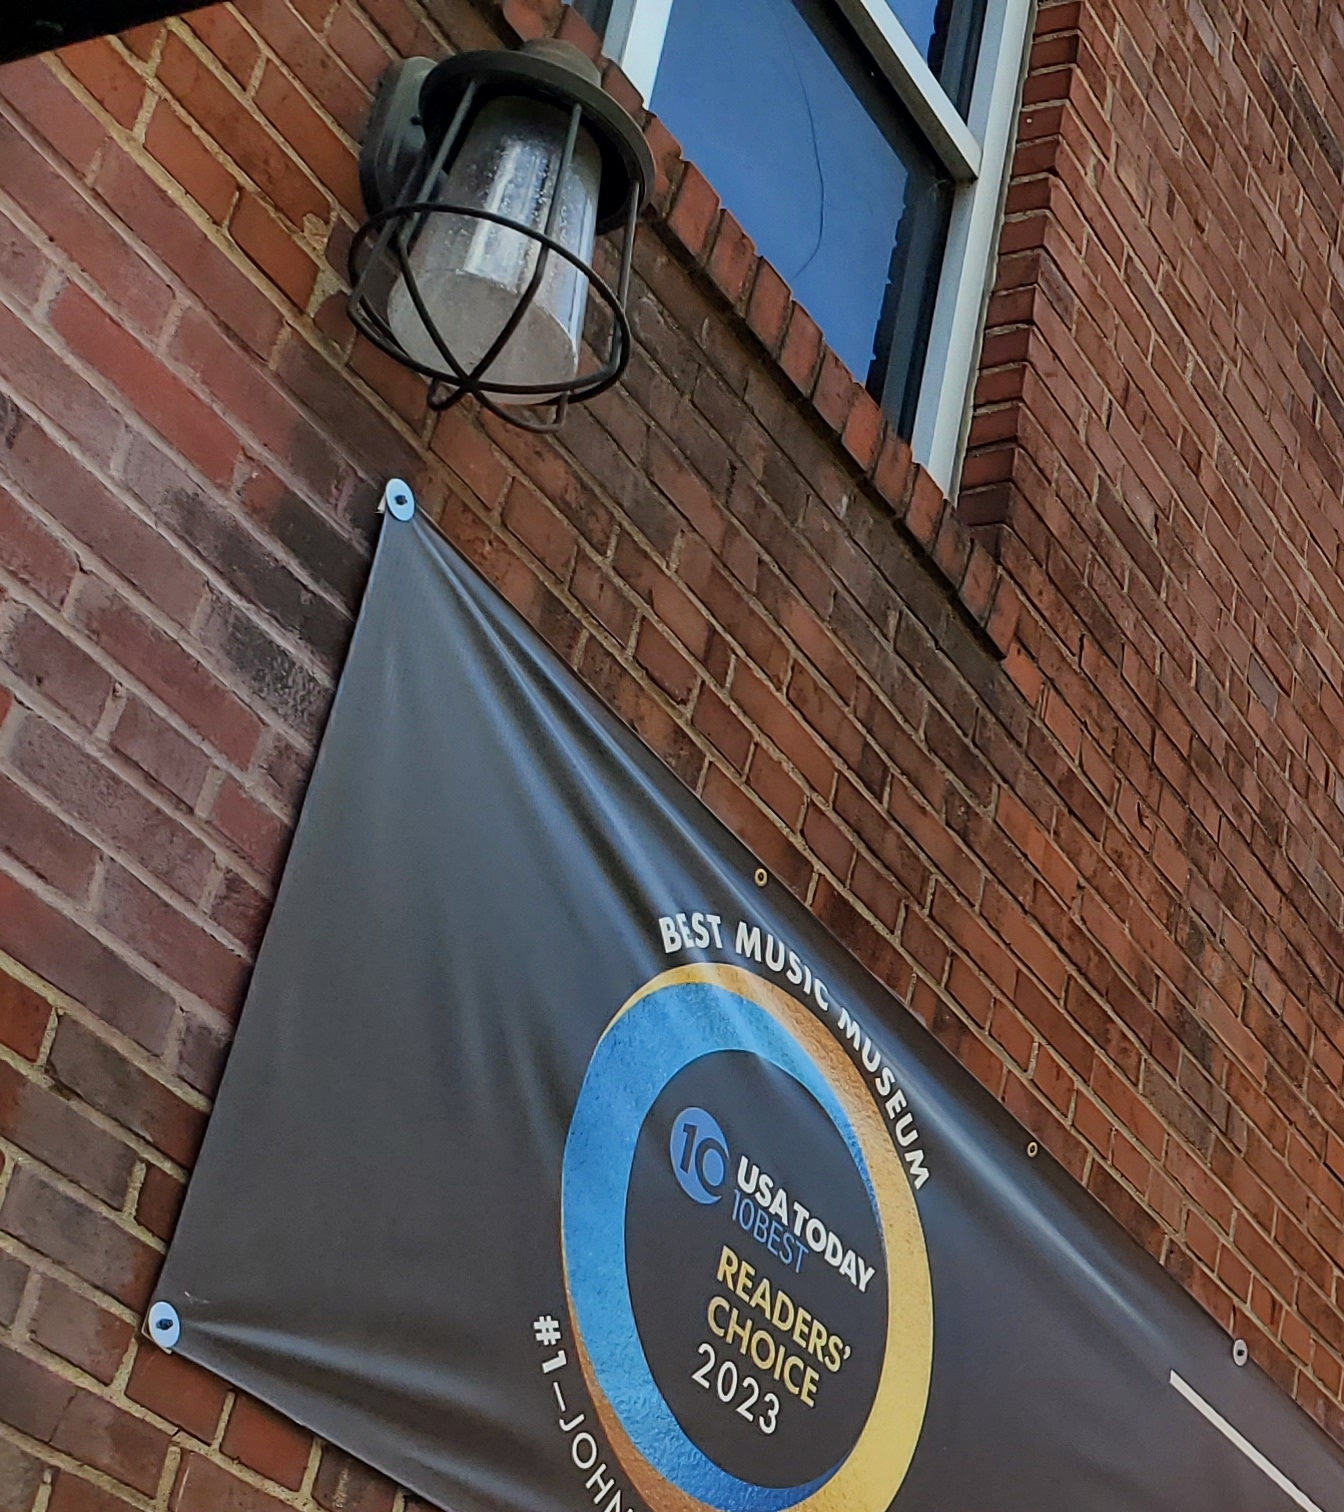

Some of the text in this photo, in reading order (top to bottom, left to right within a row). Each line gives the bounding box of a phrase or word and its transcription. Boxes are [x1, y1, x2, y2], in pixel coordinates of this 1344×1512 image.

[658, 913, 930, 1190] BEST MUSIC MUSEUM
[731, 1189, 809, 1273] 10BEST
[737, 1155, 876, 1293] USA TODAY
[533, 1315, 567, 1374] #1
[692, 1343, 781, 1435] 2023
[707, 1296, 820, 1407] CHOICE
